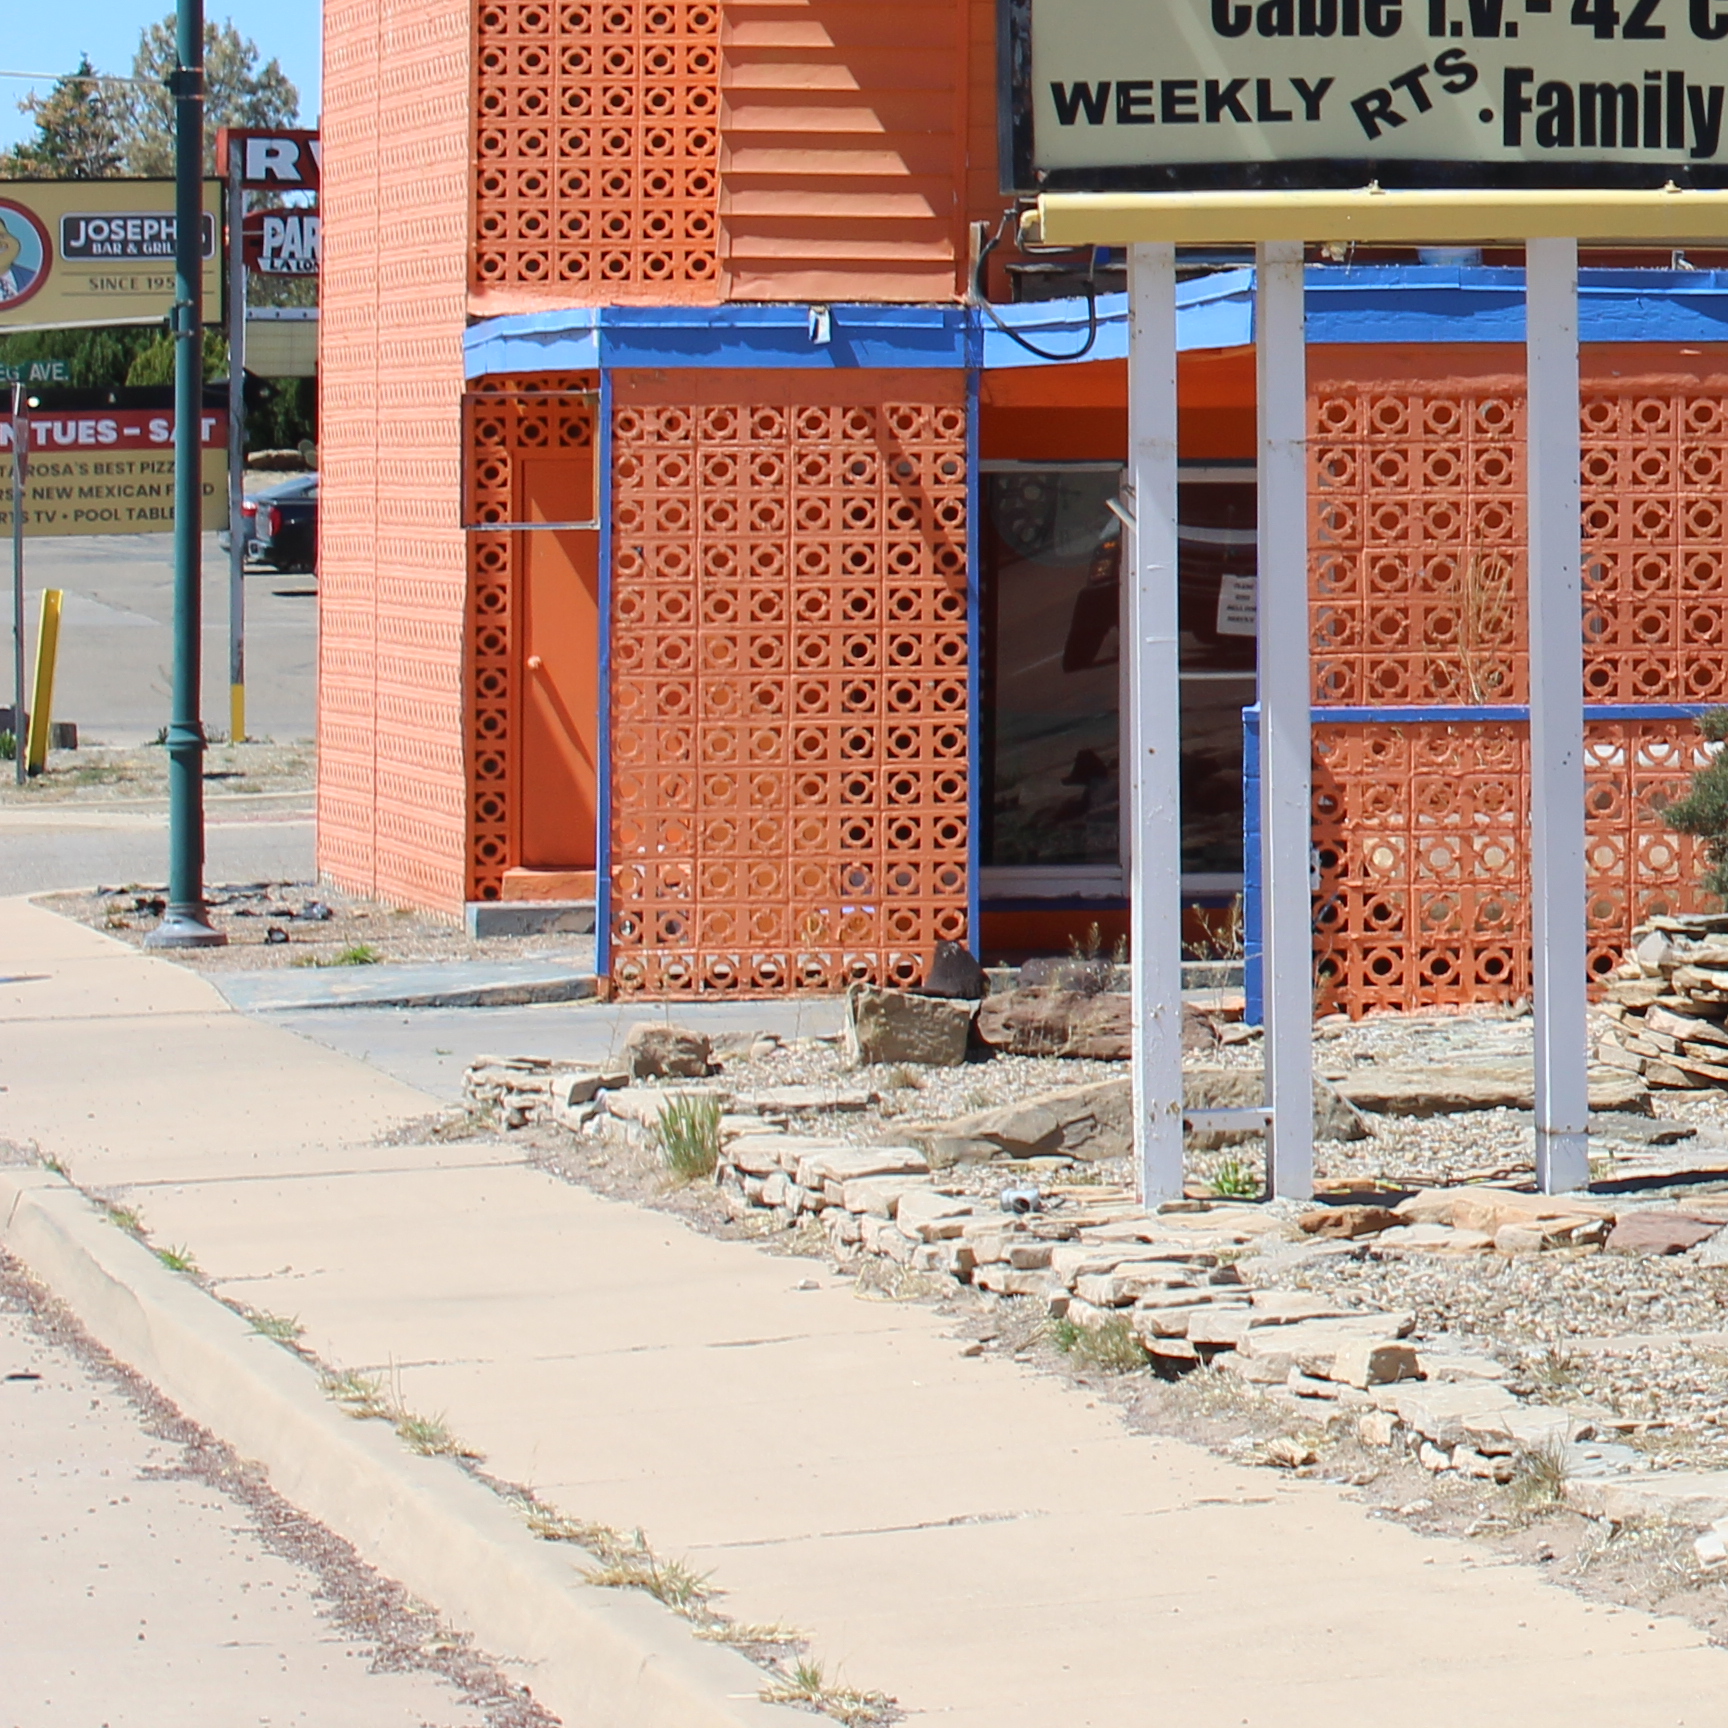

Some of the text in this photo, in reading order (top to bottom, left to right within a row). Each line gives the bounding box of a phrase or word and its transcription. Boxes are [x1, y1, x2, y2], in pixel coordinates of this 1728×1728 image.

[1049, 76, 1335, 126] WEEKLY
[1503, 66, 1725, 159] Family
[246, 137, 320, 181] R
[70, 218, 206, 248] JOSEPH
[263, 215, 320, 259] PAR
[92, 241, 177, 255] BAR & GRIL
[89, 277, 176, 290] SINCE 195
[29, 362, 69, 381] AVE.
[31, 419, 118, 446] TUES
[149, 417, 217, 443] ST
[28, 461, 89, 477] ROSA'S
[94, 460, 135, 475] BEST
[140, 460, 176, 475] PIZZ
[32, 482, 215, 500] NEW MEXICAN FD
[34, 509, 57, 524] TV
[74, 507, 121, 523] POOL
[126, 506, 176, 521] TABLE
